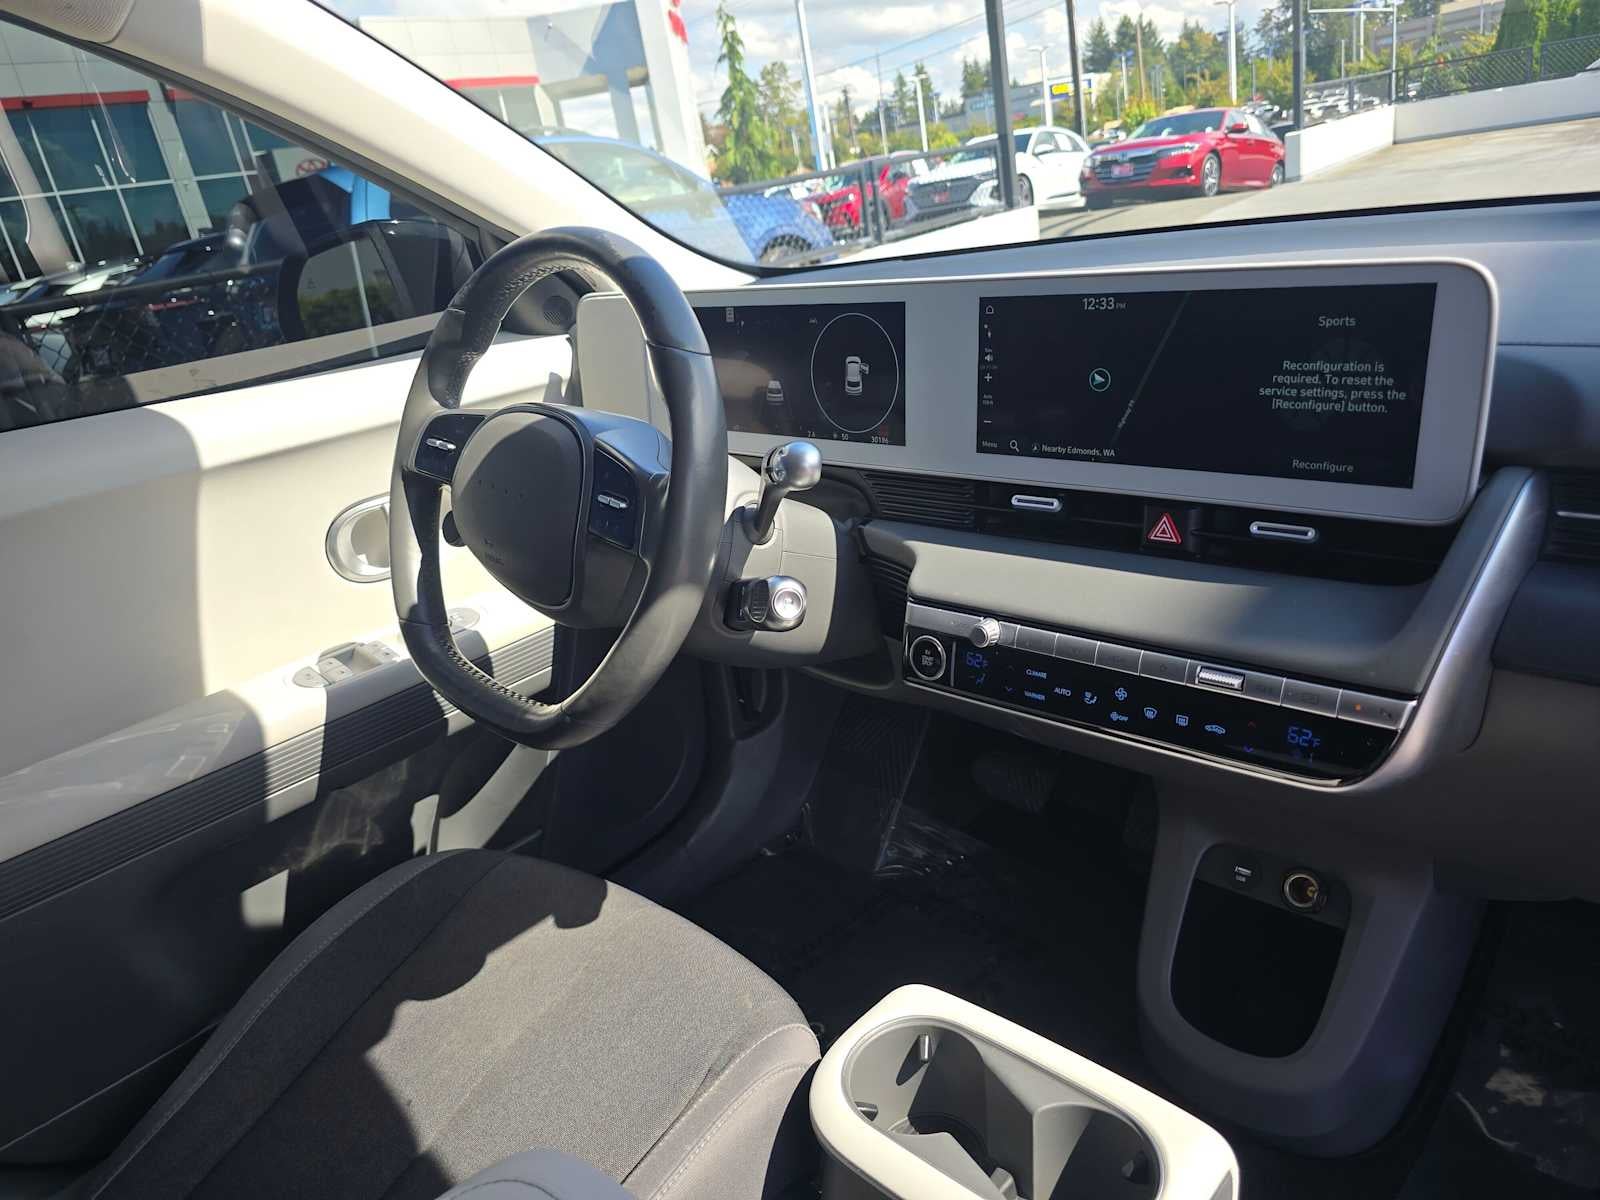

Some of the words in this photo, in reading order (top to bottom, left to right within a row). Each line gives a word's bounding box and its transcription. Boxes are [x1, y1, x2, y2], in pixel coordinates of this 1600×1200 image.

[1082, 297, 1115, 310] 12:33
[1318, 316, 1356, 328] Sports
[1283, 360, 1371, 373] Reconfiguration
[1375, 361, 1385, 372] is
[1272, 373, 1321, 386] required.
[1325, 374, 1339, 385] To
[1341, 375, 1372, 386] reset
[1374, 375, 1394, 386] the
[1259, 386, 1297, 397] service
[1300, 387, 1348, 400] settings,
[1350, 390, 1384, 401] press
[1386, 389, 1407, 401] the
[1272, 398, 1345, 413] [Reconfigure]
[1348, 401, 1388, 413] button.
[1041, 444, 1066, 455] Nearby
[1067, 446, 1102, 457] Edmonds,
[1103, 448, 1116, 457] WA
[1292, 459, 1354, 473] Reconfigure
[1053, 687, 1072, 697] AUTO
